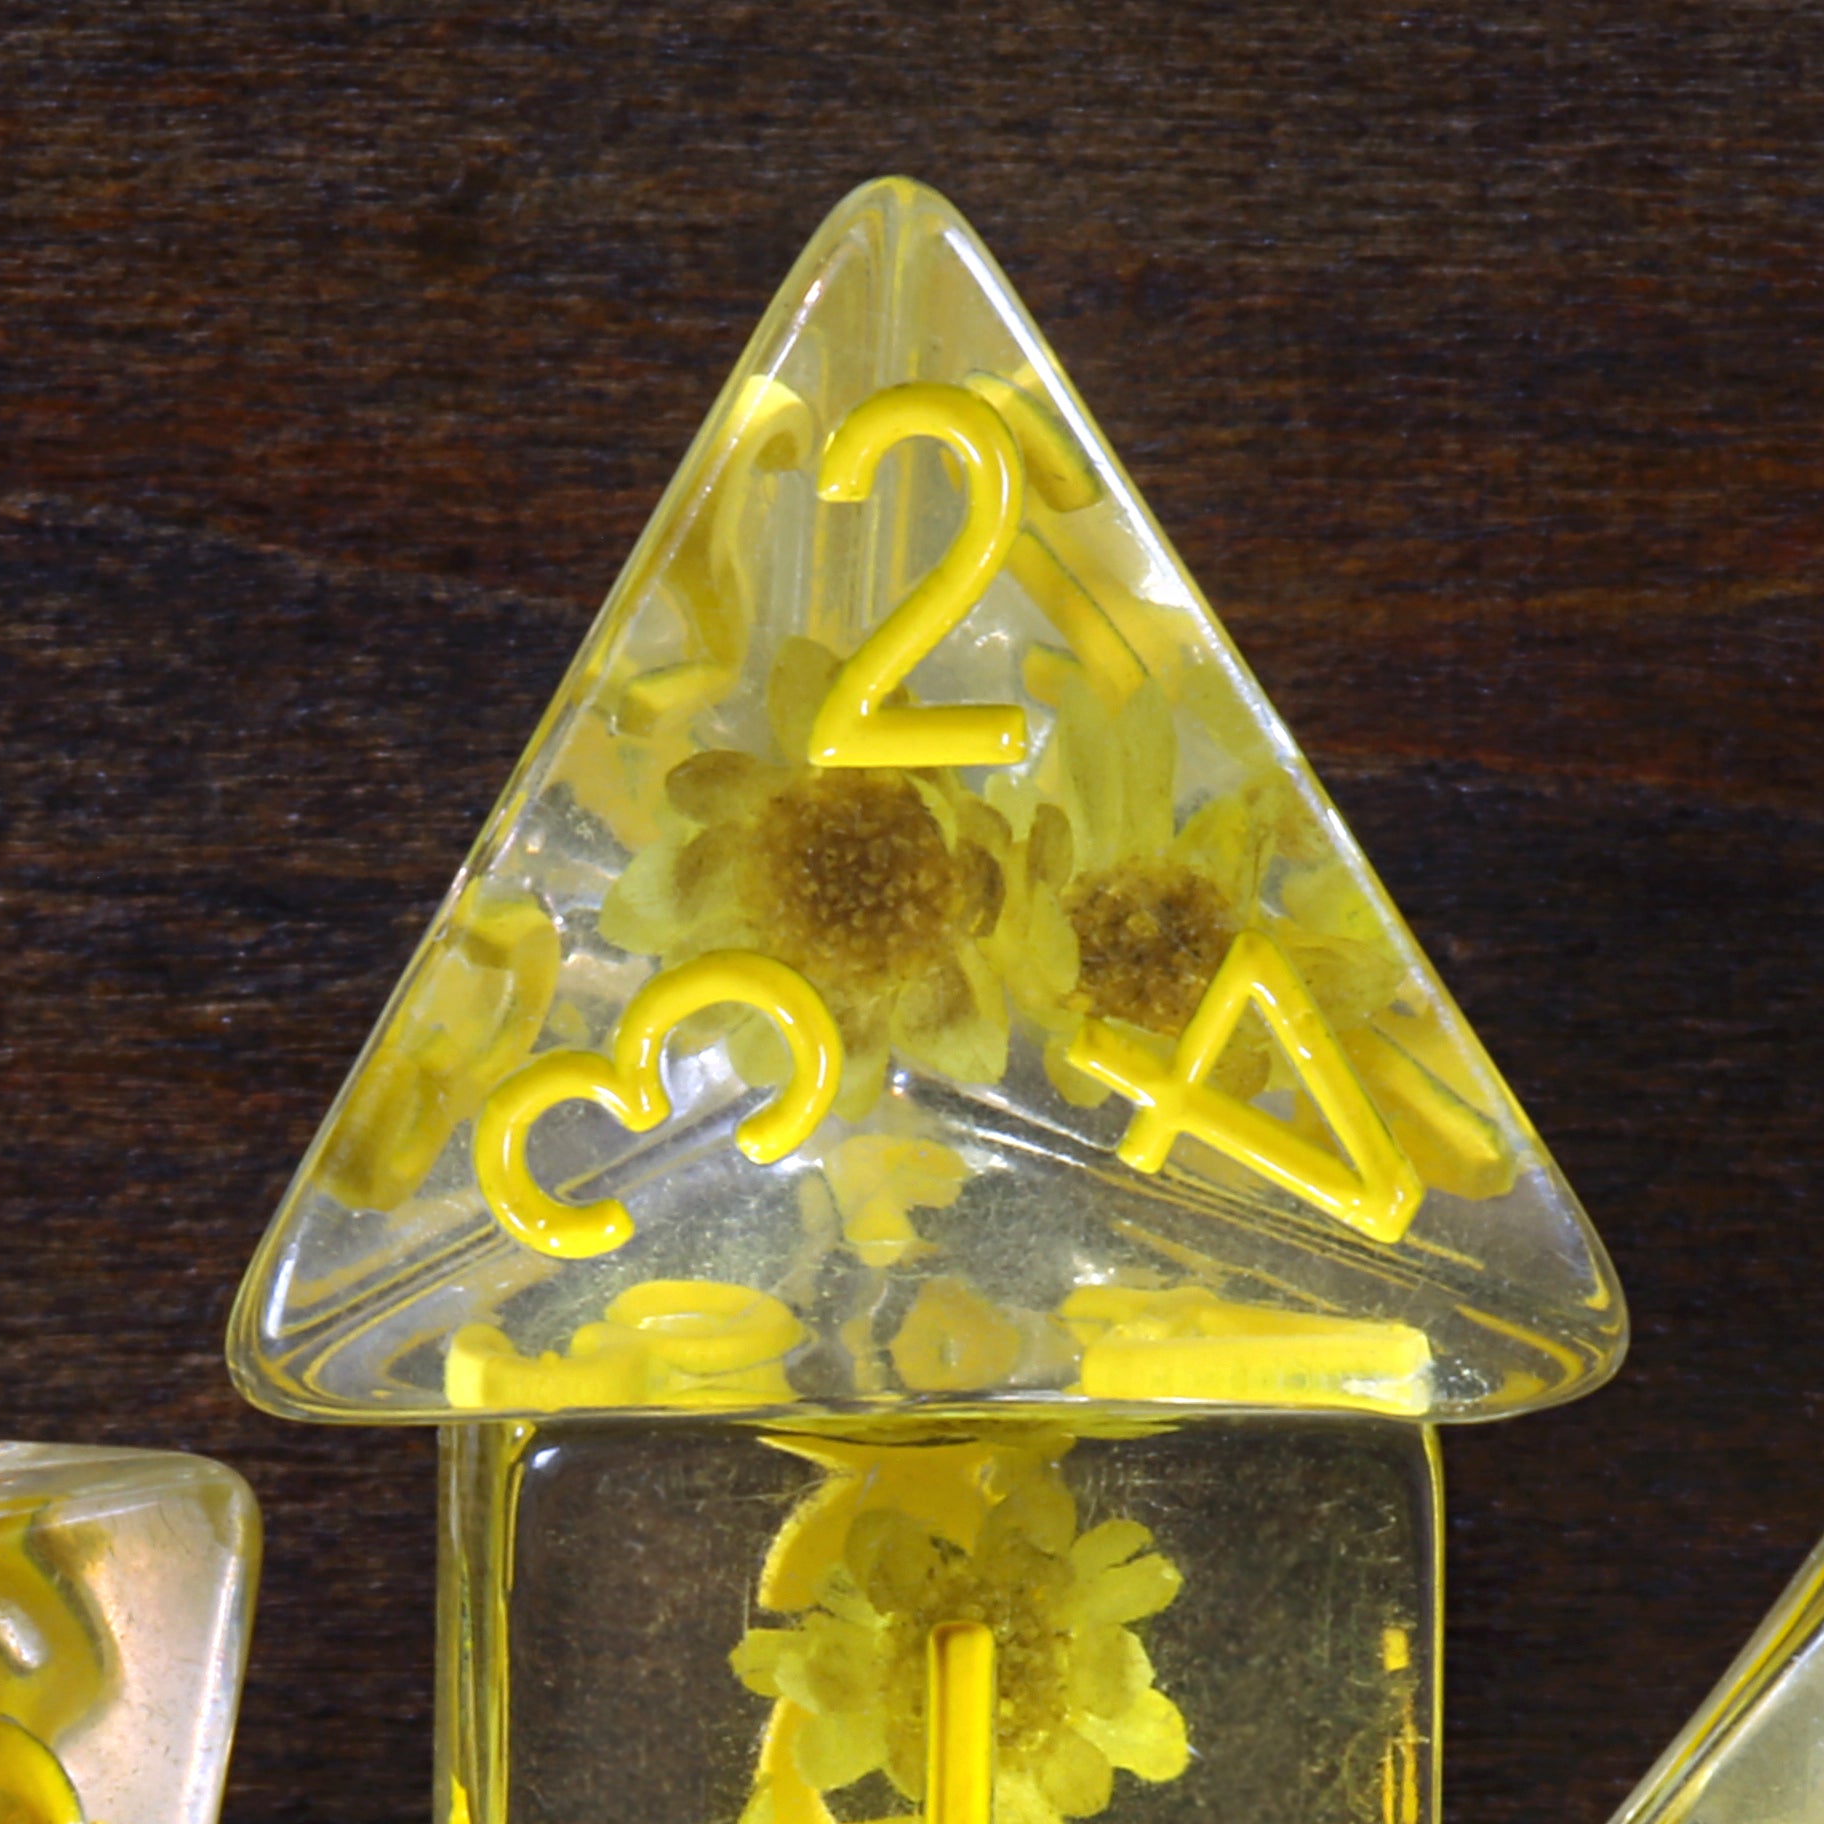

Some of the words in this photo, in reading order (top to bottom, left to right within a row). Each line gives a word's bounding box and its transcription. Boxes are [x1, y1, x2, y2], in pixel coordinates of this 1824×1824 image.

[809, 381, 1024, 768] 2
[475, 950, 842, 1258] 3
[1069, 931, 1421, 1243] 4
